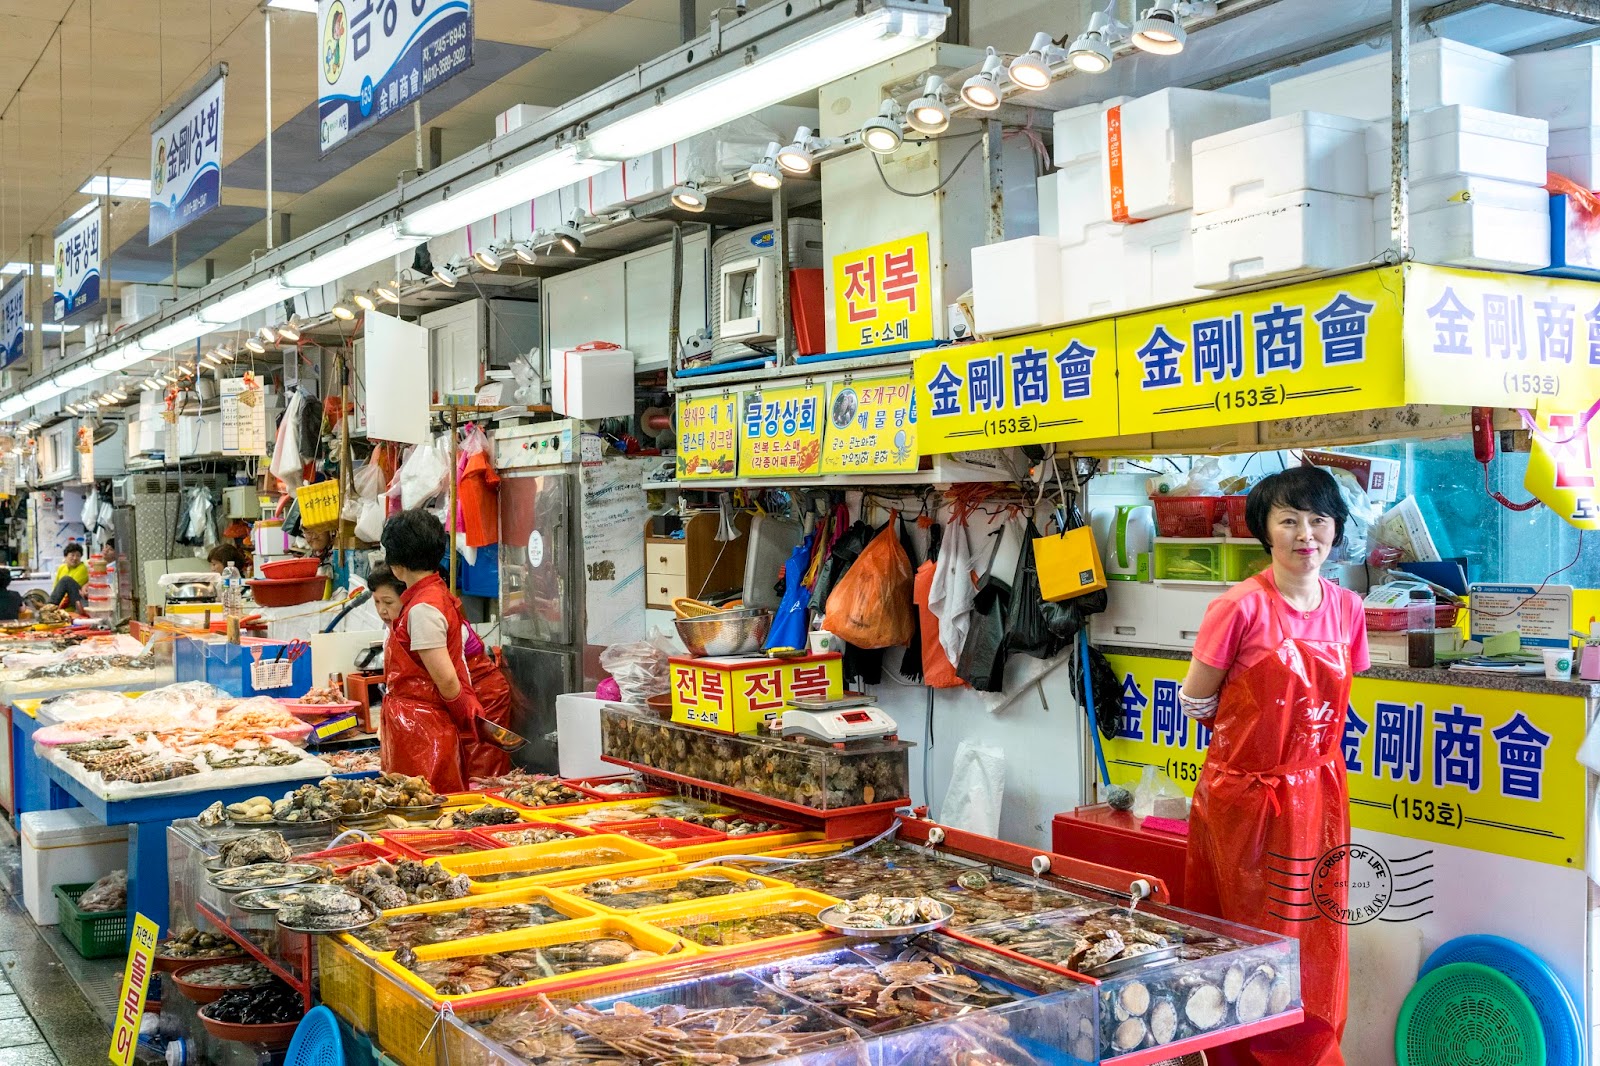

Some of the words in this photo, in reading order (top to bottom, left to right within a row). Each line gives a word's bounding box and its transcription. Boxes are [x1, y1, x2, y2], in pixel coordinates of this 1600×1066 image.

[361, 84, 372, 107] 153
[379, 67, 419, 114] 金剛商會
[166, 96, 220, 184] 金剛상회
[65, 219, 99, 277] 하동상회
[843, 247, 919, 323] 전복
[1136, 293, 1375, 389] 金剛商會
[859, 383, 910, 405] 조개구이
[927, 340, 1097, 417] 金剛商會
[1214, 384, 1286, 412] (153호)
[1502, 371, 1560, 397] (153호)
[746, 397, 818, 438] 금강상회
[983, 414, 1038, 438] (153호)
[753, 441, 769, 454] 전복
[677, 668, 724, 711] 전복
[743, 664, 831, 712] 전복
[1115, 673, 1213, 750] 金剛
[1166, 757, 1204, 782] (153
[1392, 793, 1463, 830] (153호)
[135, 925, 154, 950] 자연산
